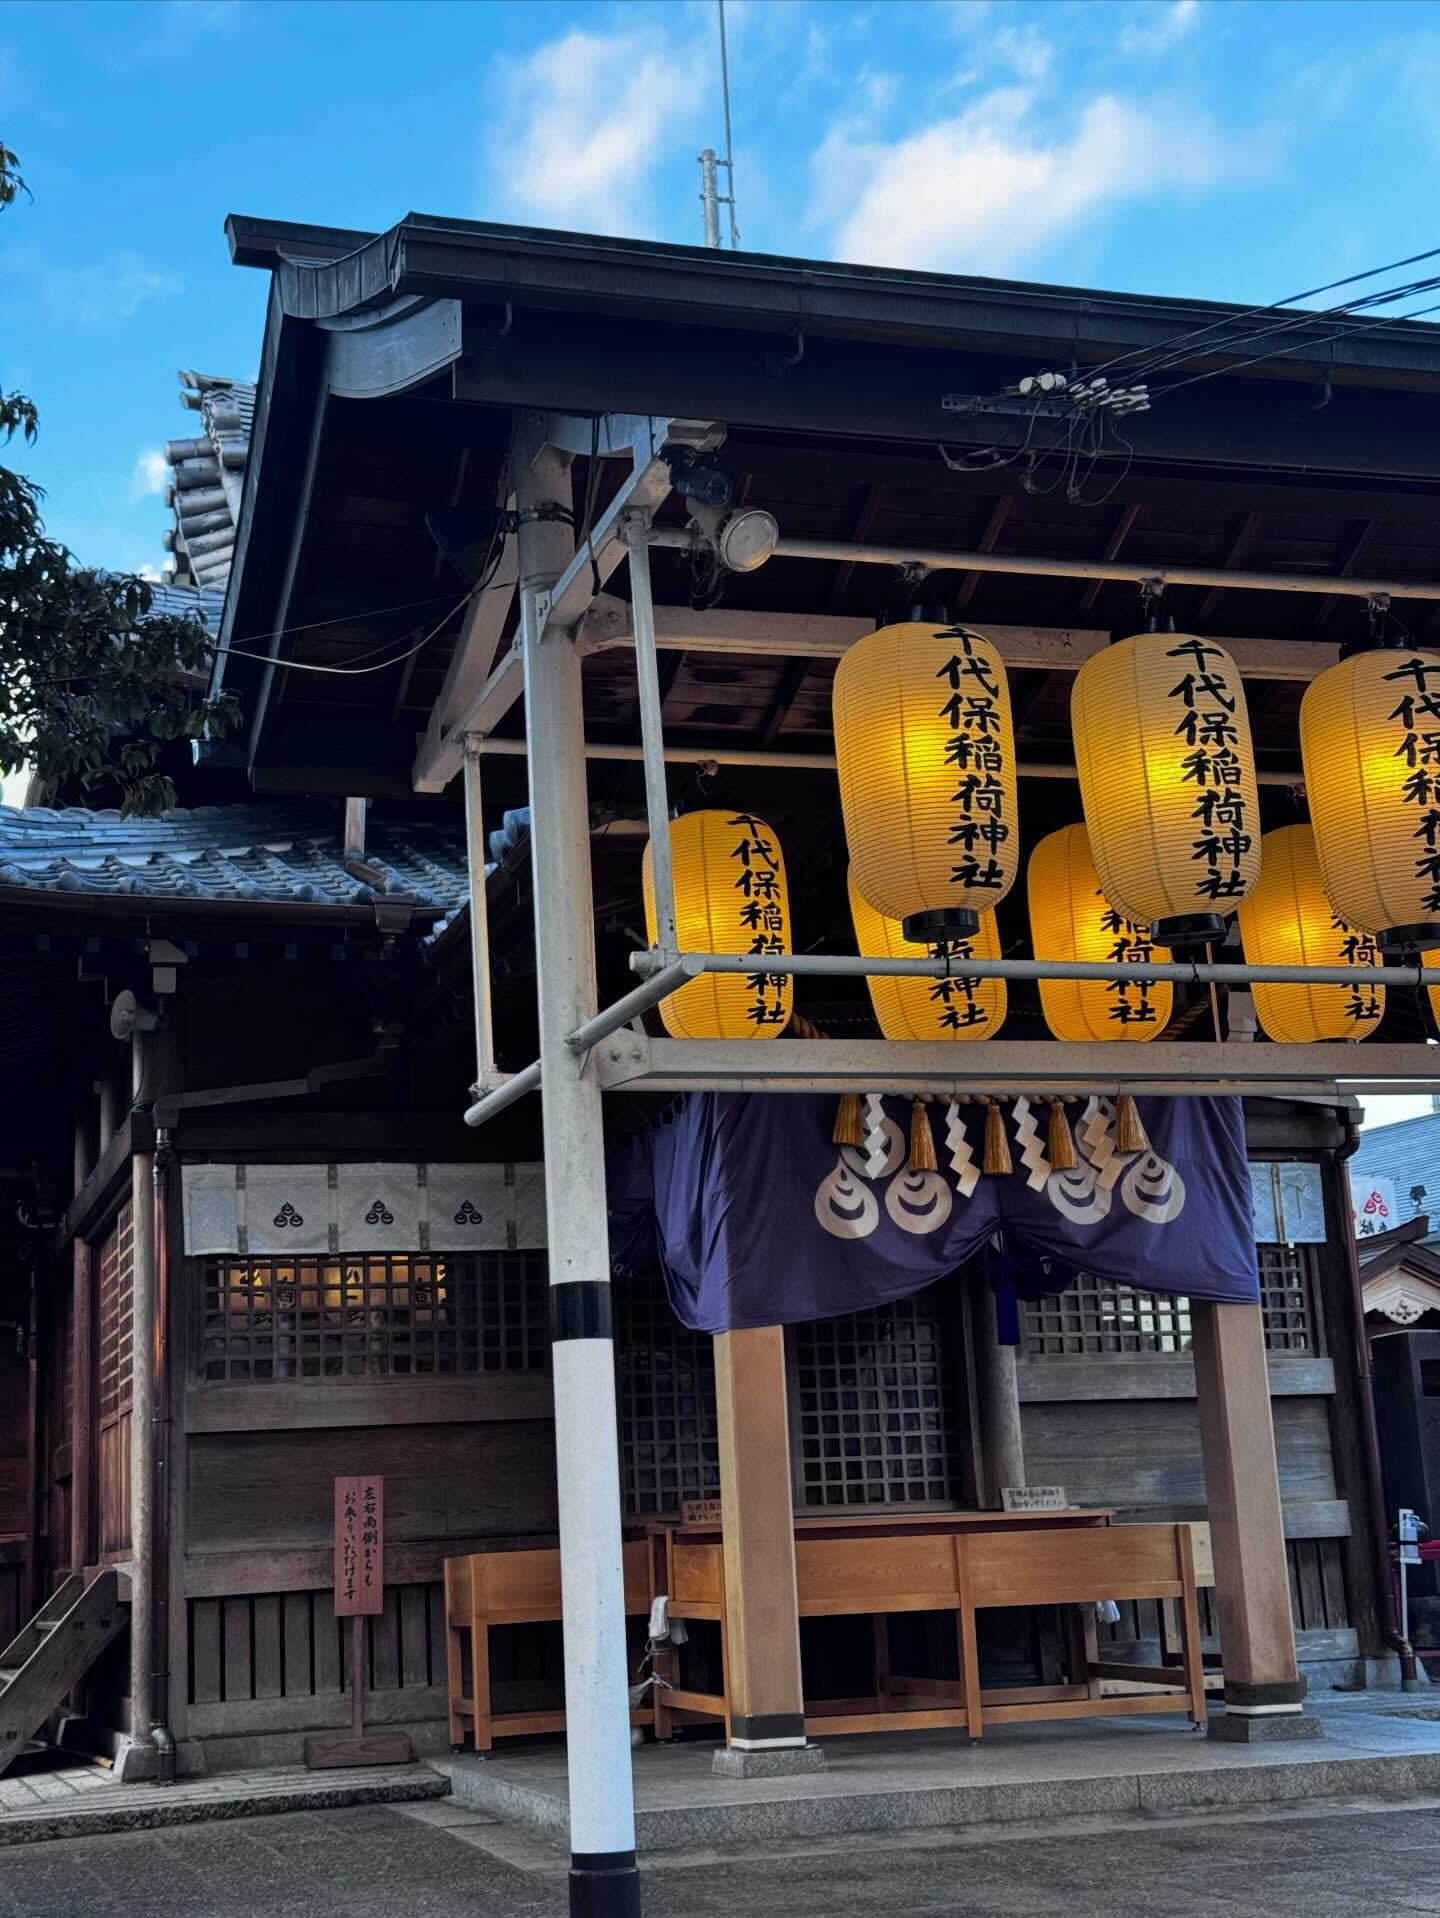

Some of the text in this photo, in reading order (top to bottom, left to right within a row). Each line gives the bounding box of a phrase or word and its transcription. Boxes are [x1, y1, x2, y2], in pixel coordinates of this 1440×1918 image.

[931, 626, 1009, 889] 千代保稲荷神社
[1166, 639, 1252, 900] 千代保稲荷神社
[343, 1491, 358, 1601] お参りいただけます
[362, 1486, 378, 1588] 左右両側からも
